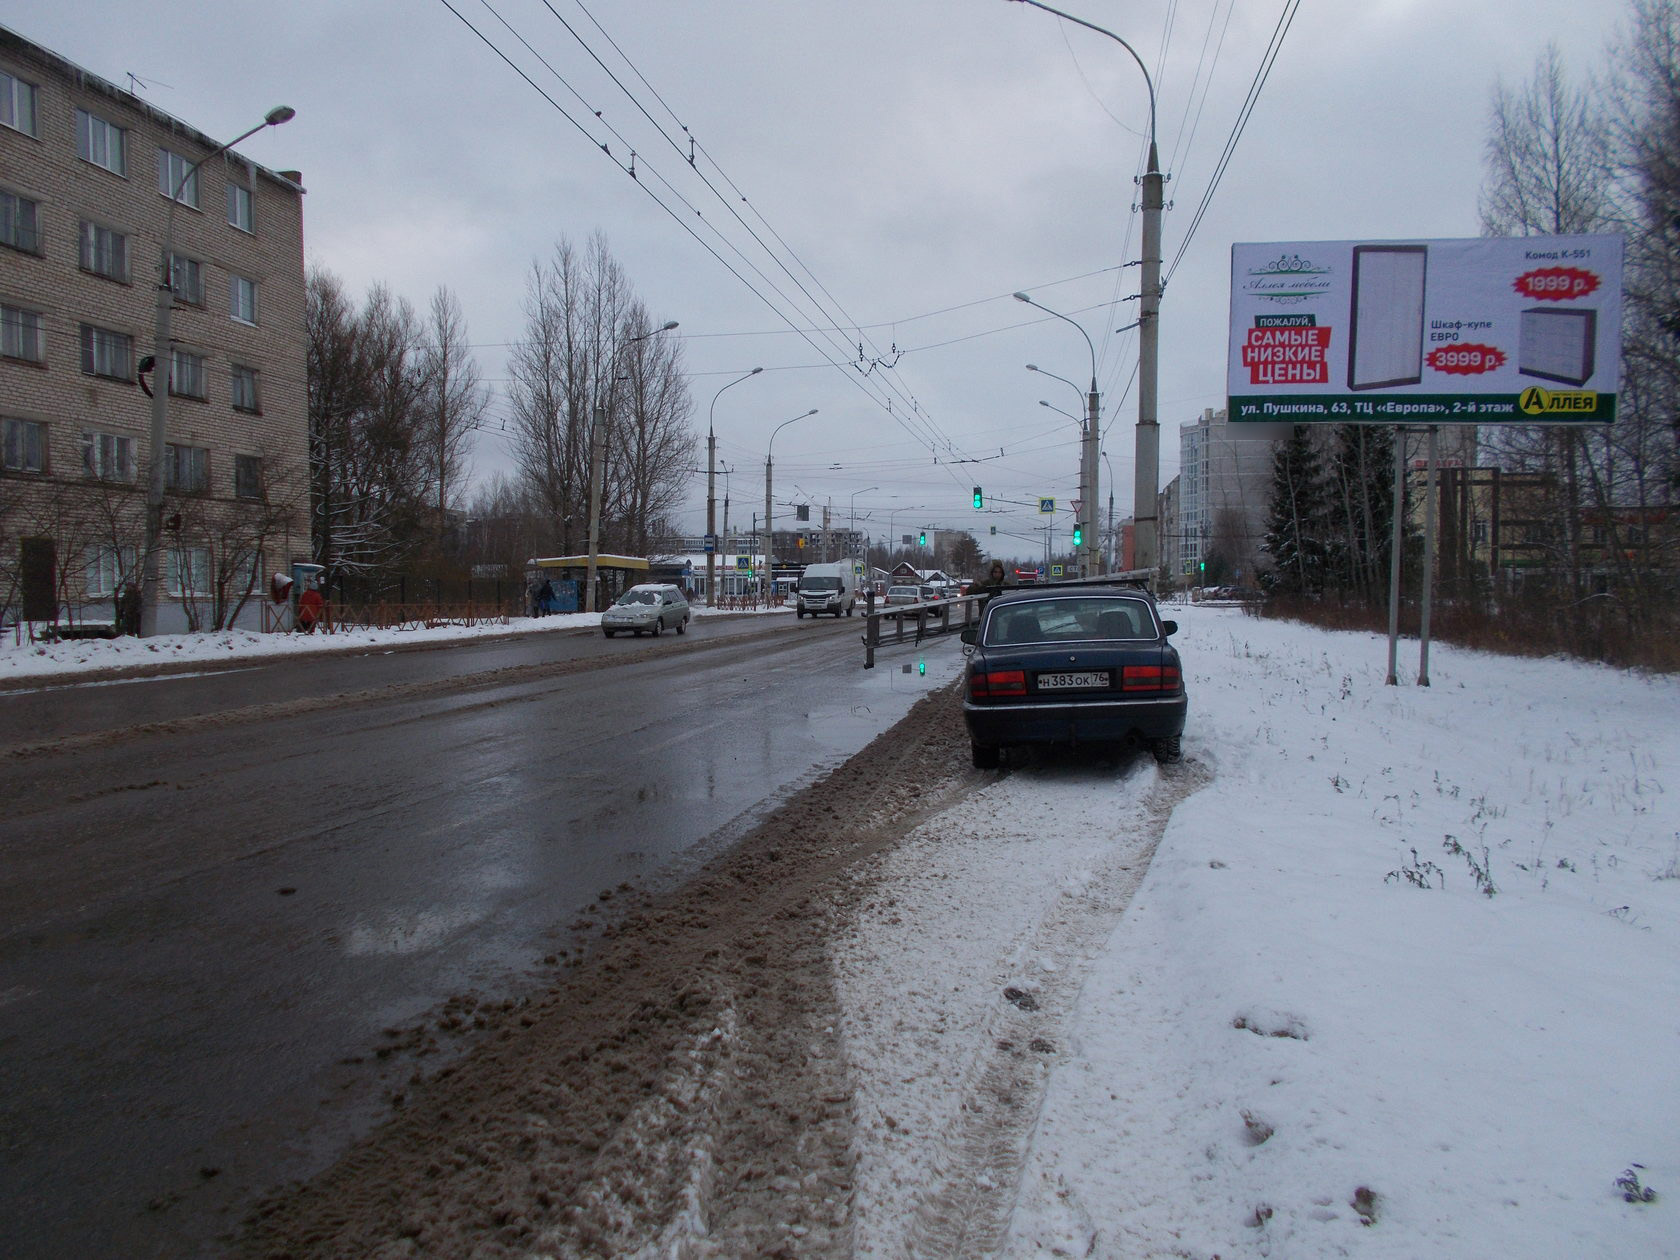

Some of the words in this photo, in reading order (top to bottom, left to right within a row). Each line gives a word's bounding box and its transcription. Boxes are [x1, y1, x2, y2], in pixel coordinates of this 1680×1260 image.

[1525, 250, 1559, 260] Комод
[1561, 249, 1591, 259] К-551
[1526, 275, 1570, 291] 1999
[1573, 278, 1588, 294] р.
[1260, 316, 1312, 327] ПОЖАЛУЙ,
[1431, 319, 1493, 331] Шкаф-купе
[1250, 329, 1319, 346] САМЫЕ
[1430, 331, 1460, 341] ЕВРО
[1246, 345, 1322, 362] НИЗКИЕ
[1435, 351, 1482, 366] 3999
[1485, 354, 1499, 369] р.
[1258, 362, 1321, 384] ЦЕНЫ
[1241, 404, 1260, 416] ул.
[1263, 402, 1328, 416] Пушкина,
[1331, 402, 1351, 415] 63,
[1355, 402, 1373, 415] ТЦ
[1453, 401, 1476, 413] 2-й
[1479, 404, 1514, 413] этаж
